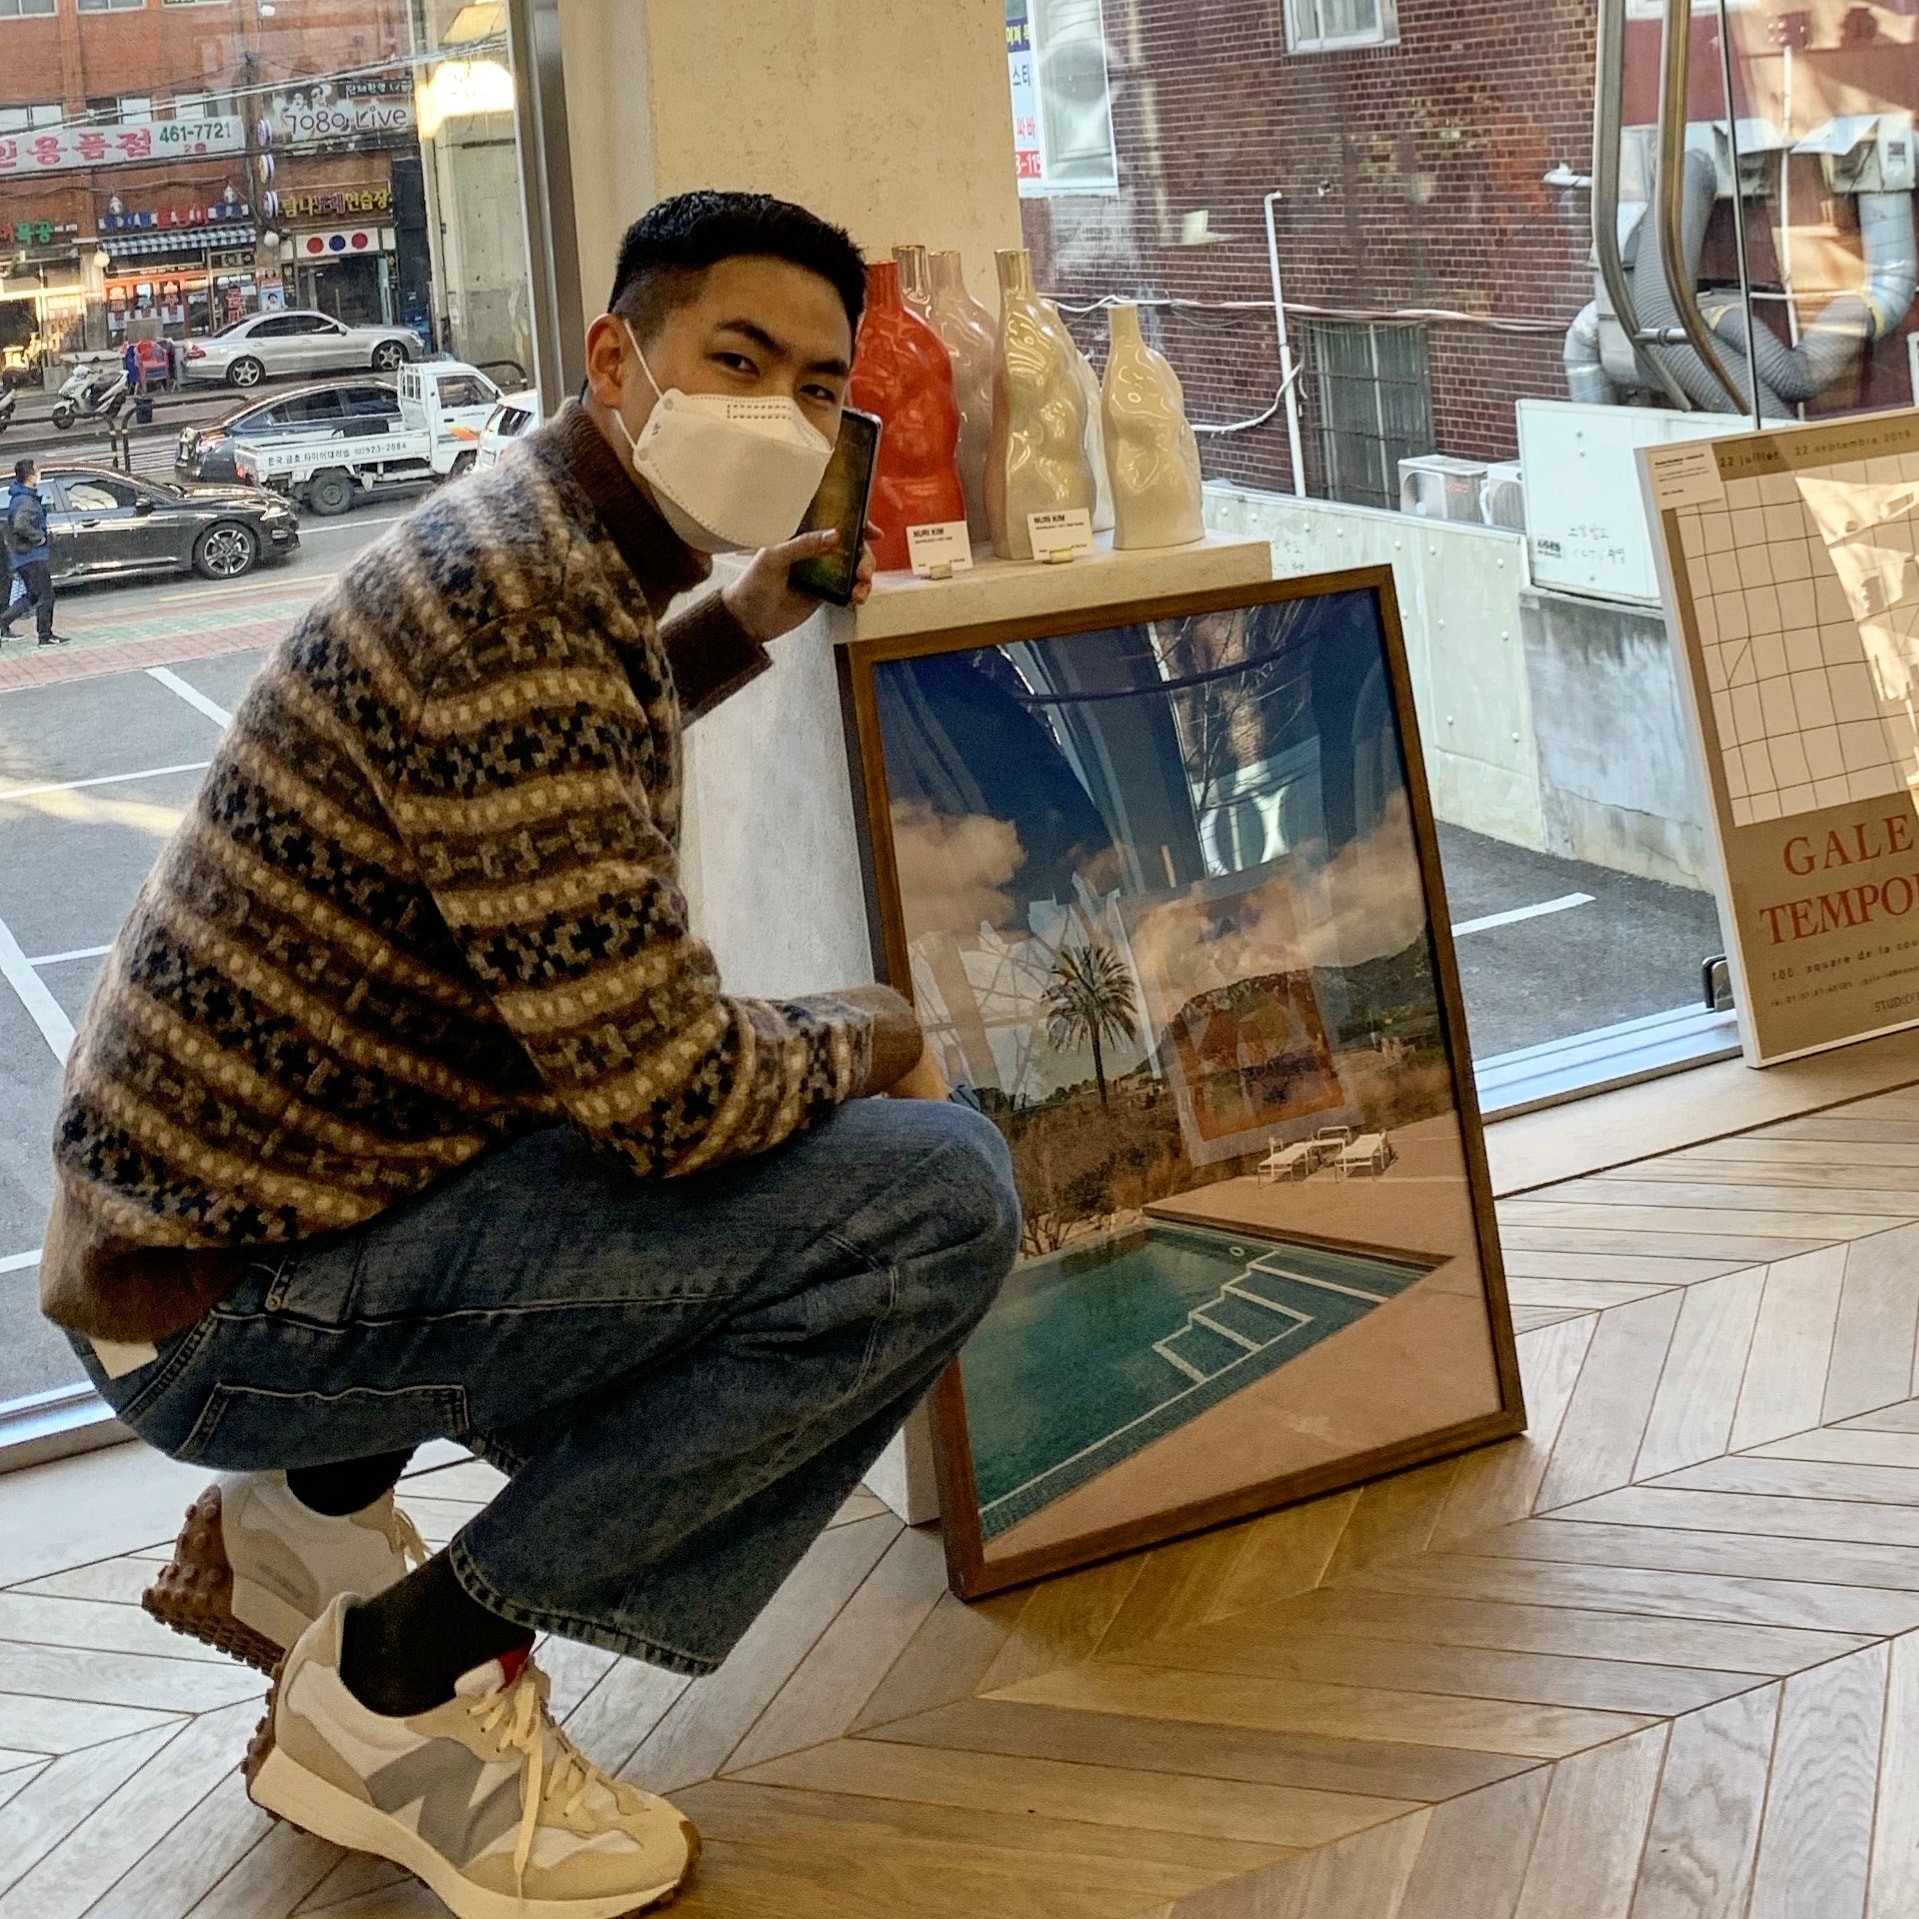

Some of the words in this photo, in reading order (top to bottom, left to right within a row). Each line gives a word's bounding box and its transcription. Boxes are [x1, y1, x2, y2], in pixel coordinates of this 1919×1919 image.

[159, 121, 231, 143] 461-7721
[285, 110, 346, 135] 7080
[356, 106, 407, 129] Live
[1783, 814, 1914, 876] GALE
